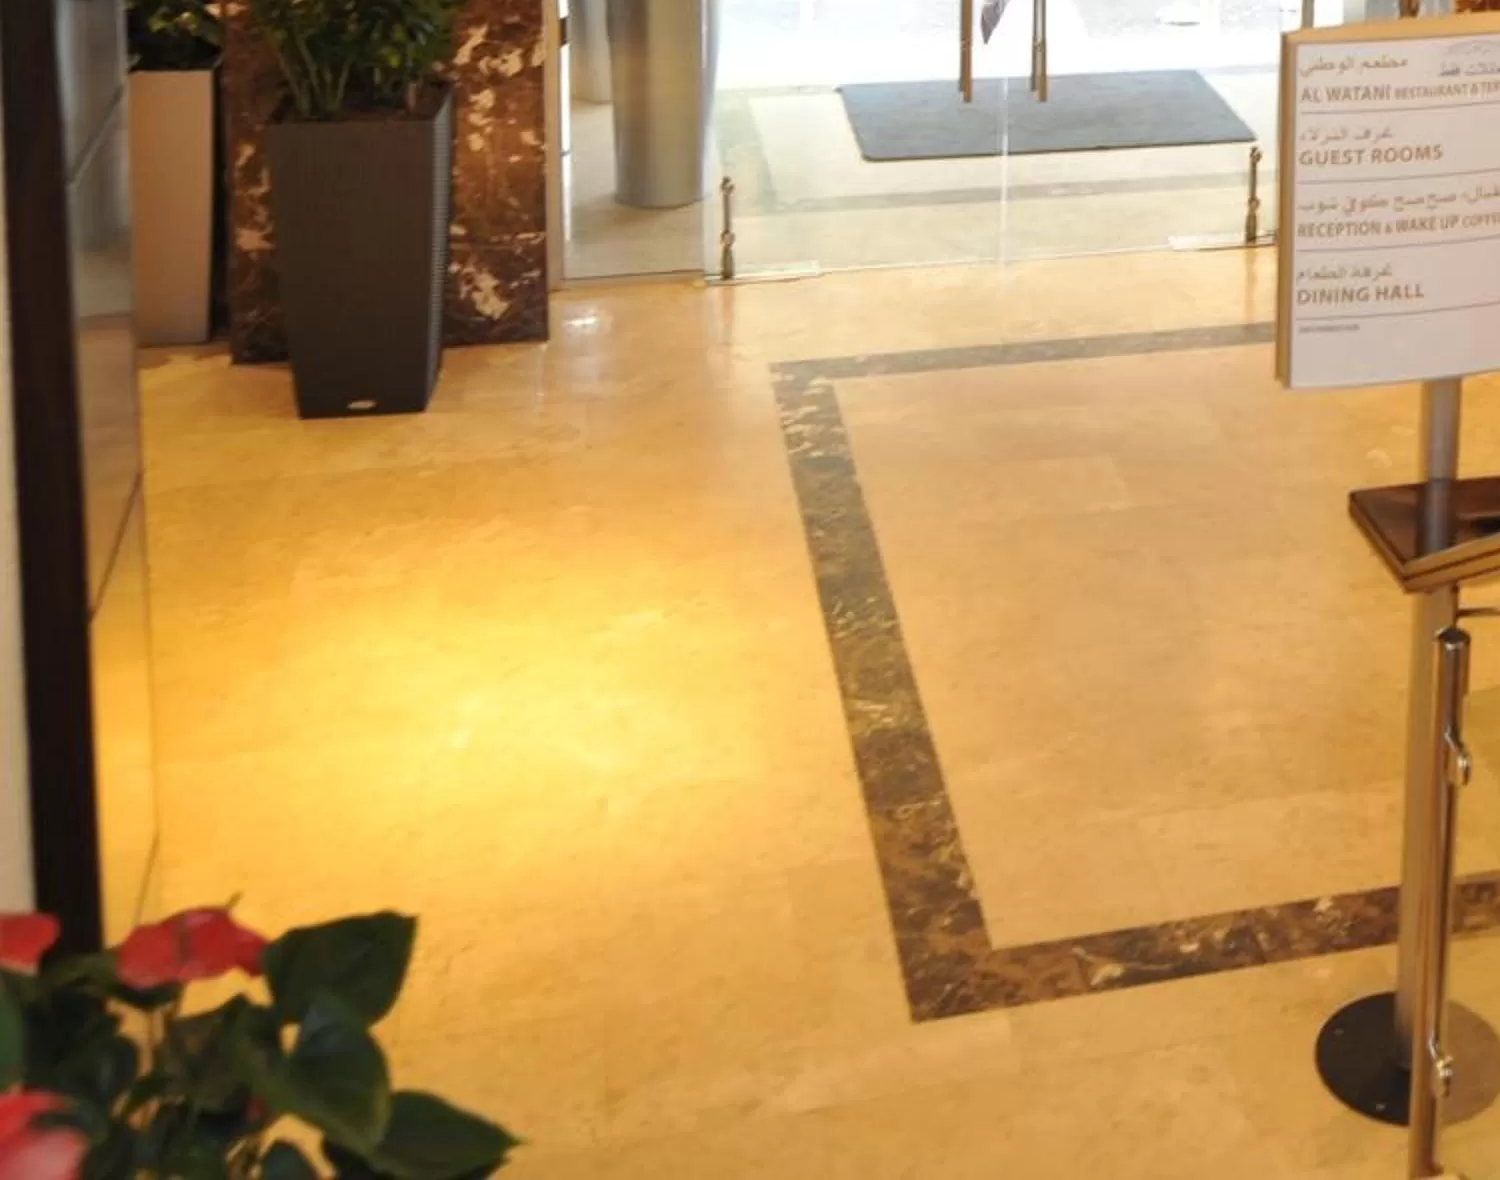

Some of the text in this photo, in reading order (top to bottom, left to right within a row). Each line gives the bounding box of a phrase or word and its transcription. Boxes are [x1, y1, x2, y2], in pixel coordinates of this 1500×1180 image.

[1300, 88, 1321, 103] AL
[1326, 84, 1392, 102] WATANI
[1298, 144, 1444, 167] GUEST ROOMS
[1297, 220, 1383, 238] RECEPTION
[1396, 216, 1437, 233] WAKE
[1440, 214, 1460, 230] UP
[1297, 282, 1425, 306] DINING HALL
